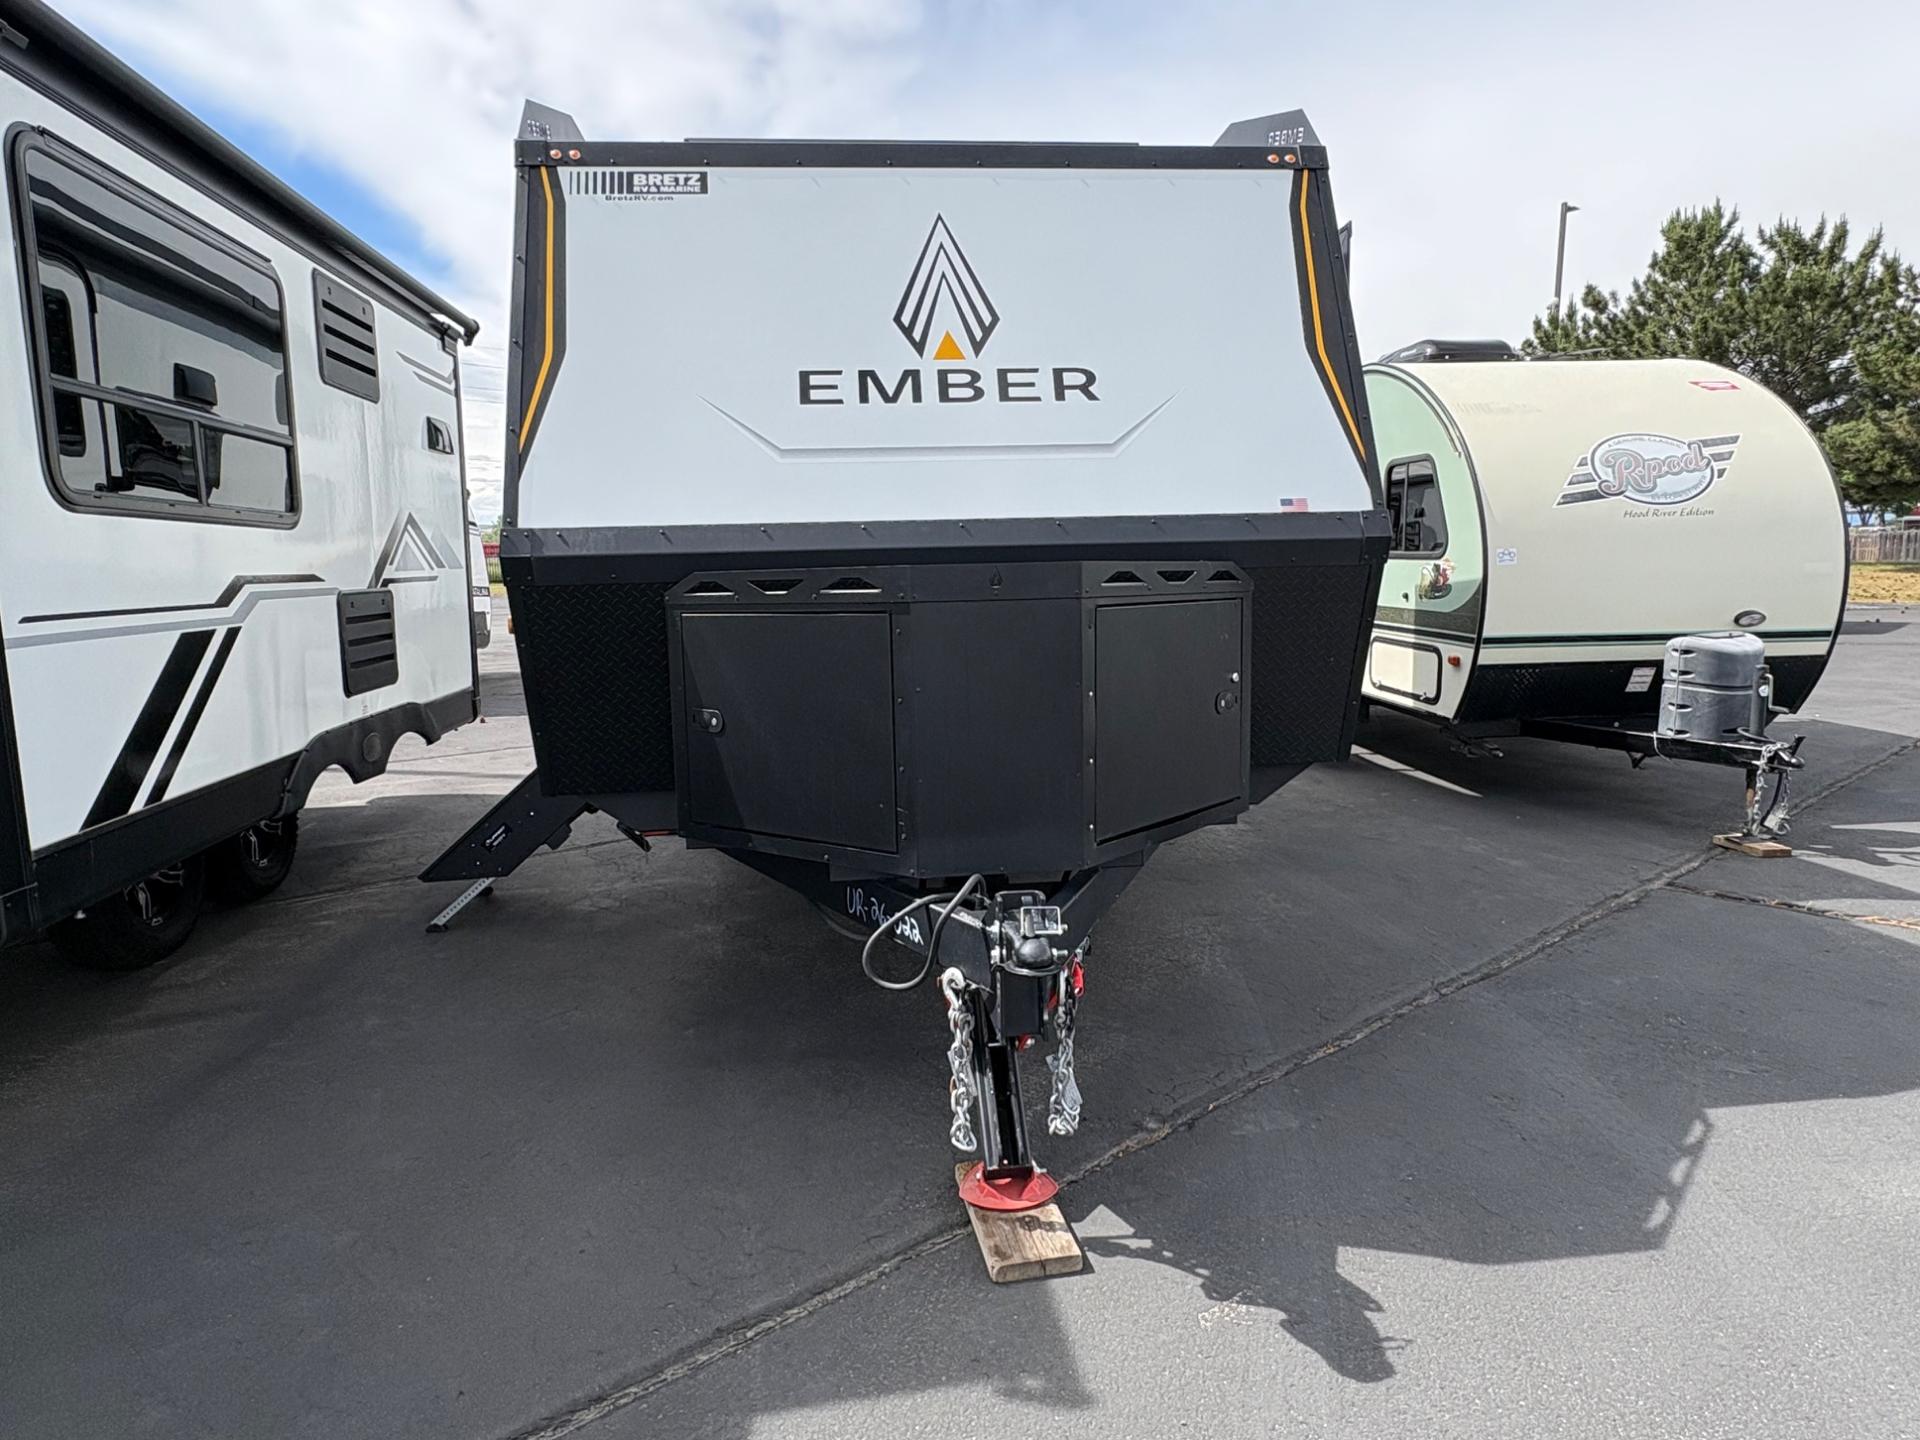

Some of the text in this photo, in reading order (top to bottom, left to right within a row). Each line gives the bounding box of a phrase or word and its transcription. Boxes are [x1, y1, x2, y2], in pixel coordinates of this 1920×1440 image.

[632, 173, 701, 186] BRETZ
[798, 367, 1101, 405] EMBER
[1651, 508, 1678, 518] River
[1680, 506, 1714, 517] Edition
